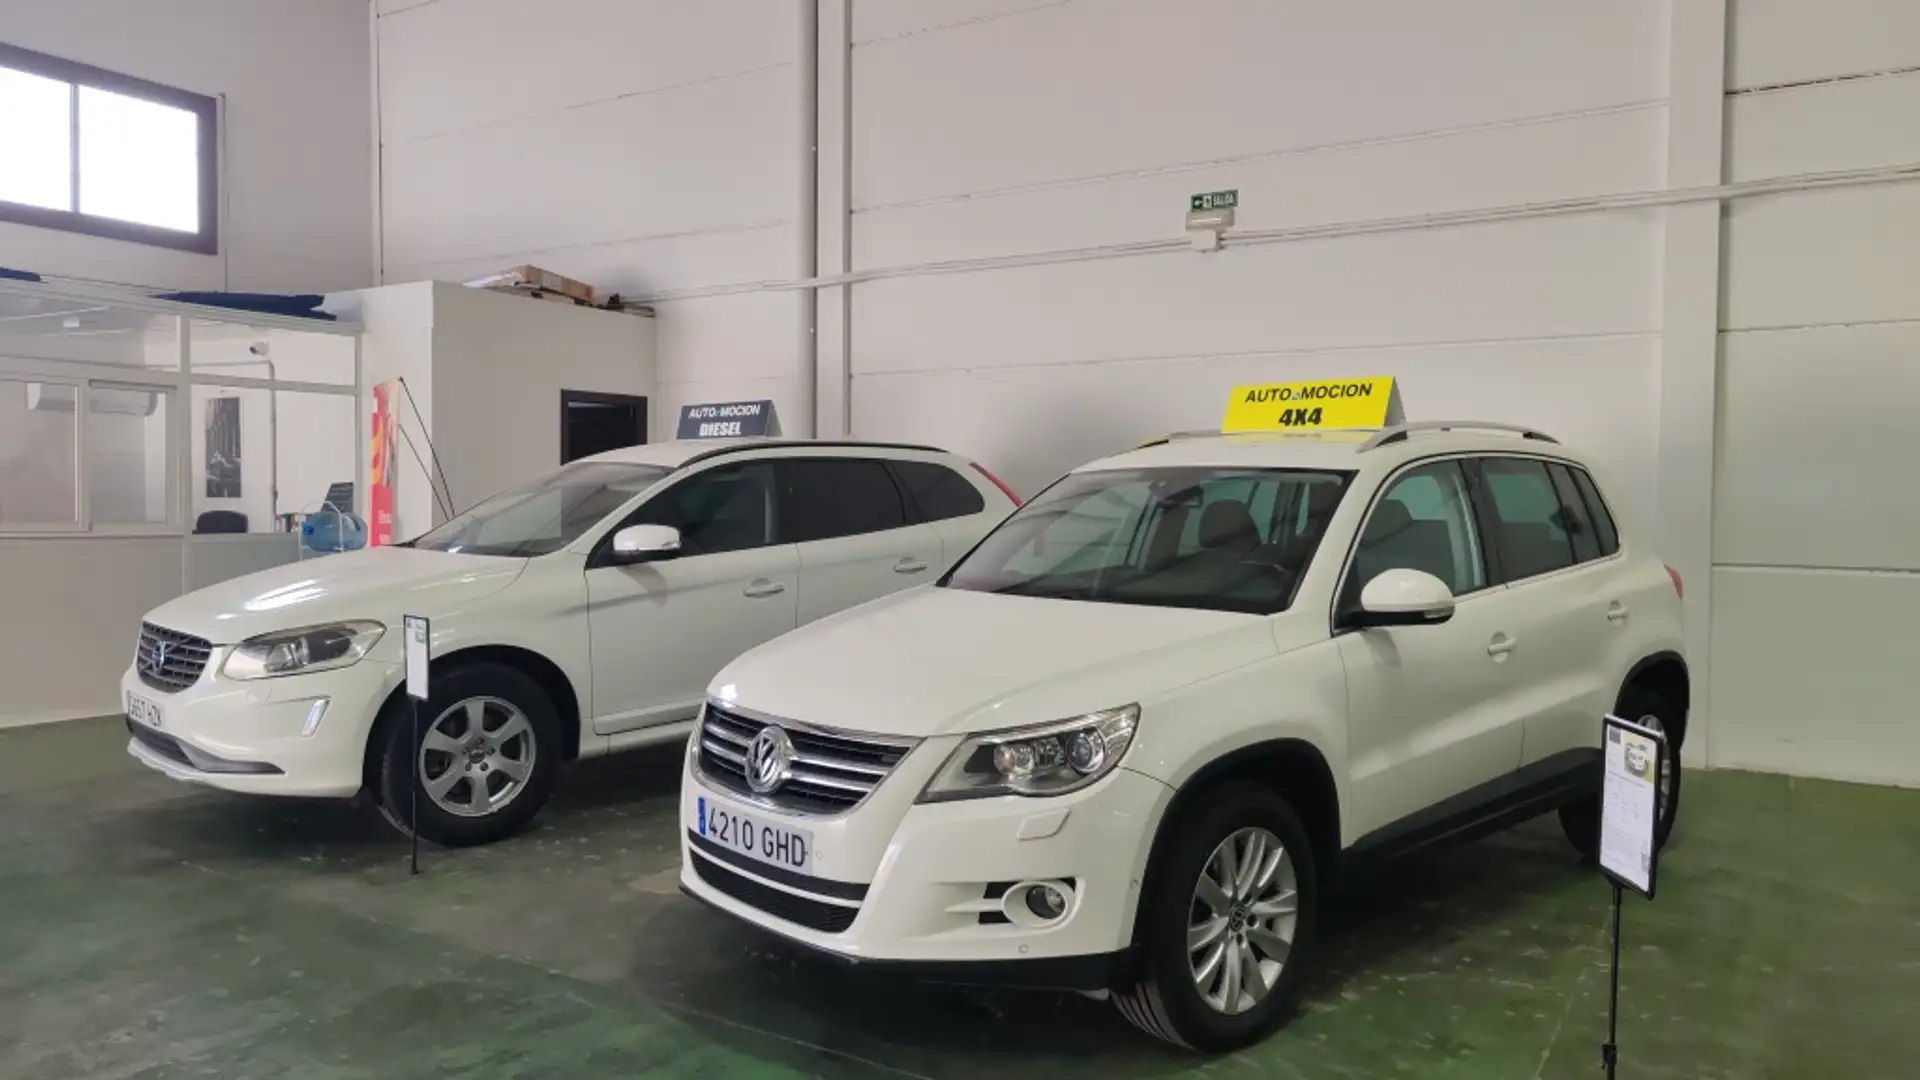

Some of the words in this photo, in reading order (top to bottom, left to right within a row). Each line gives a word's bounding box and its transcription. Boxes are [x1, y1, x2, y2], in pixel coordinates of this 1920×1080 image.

[1278, 407, 1323, 426] 4X4
[699, 422, 742, 437] DIESEL
[709, 807, 754, 851] 4210
[761, 826, 806, 867] GHD
